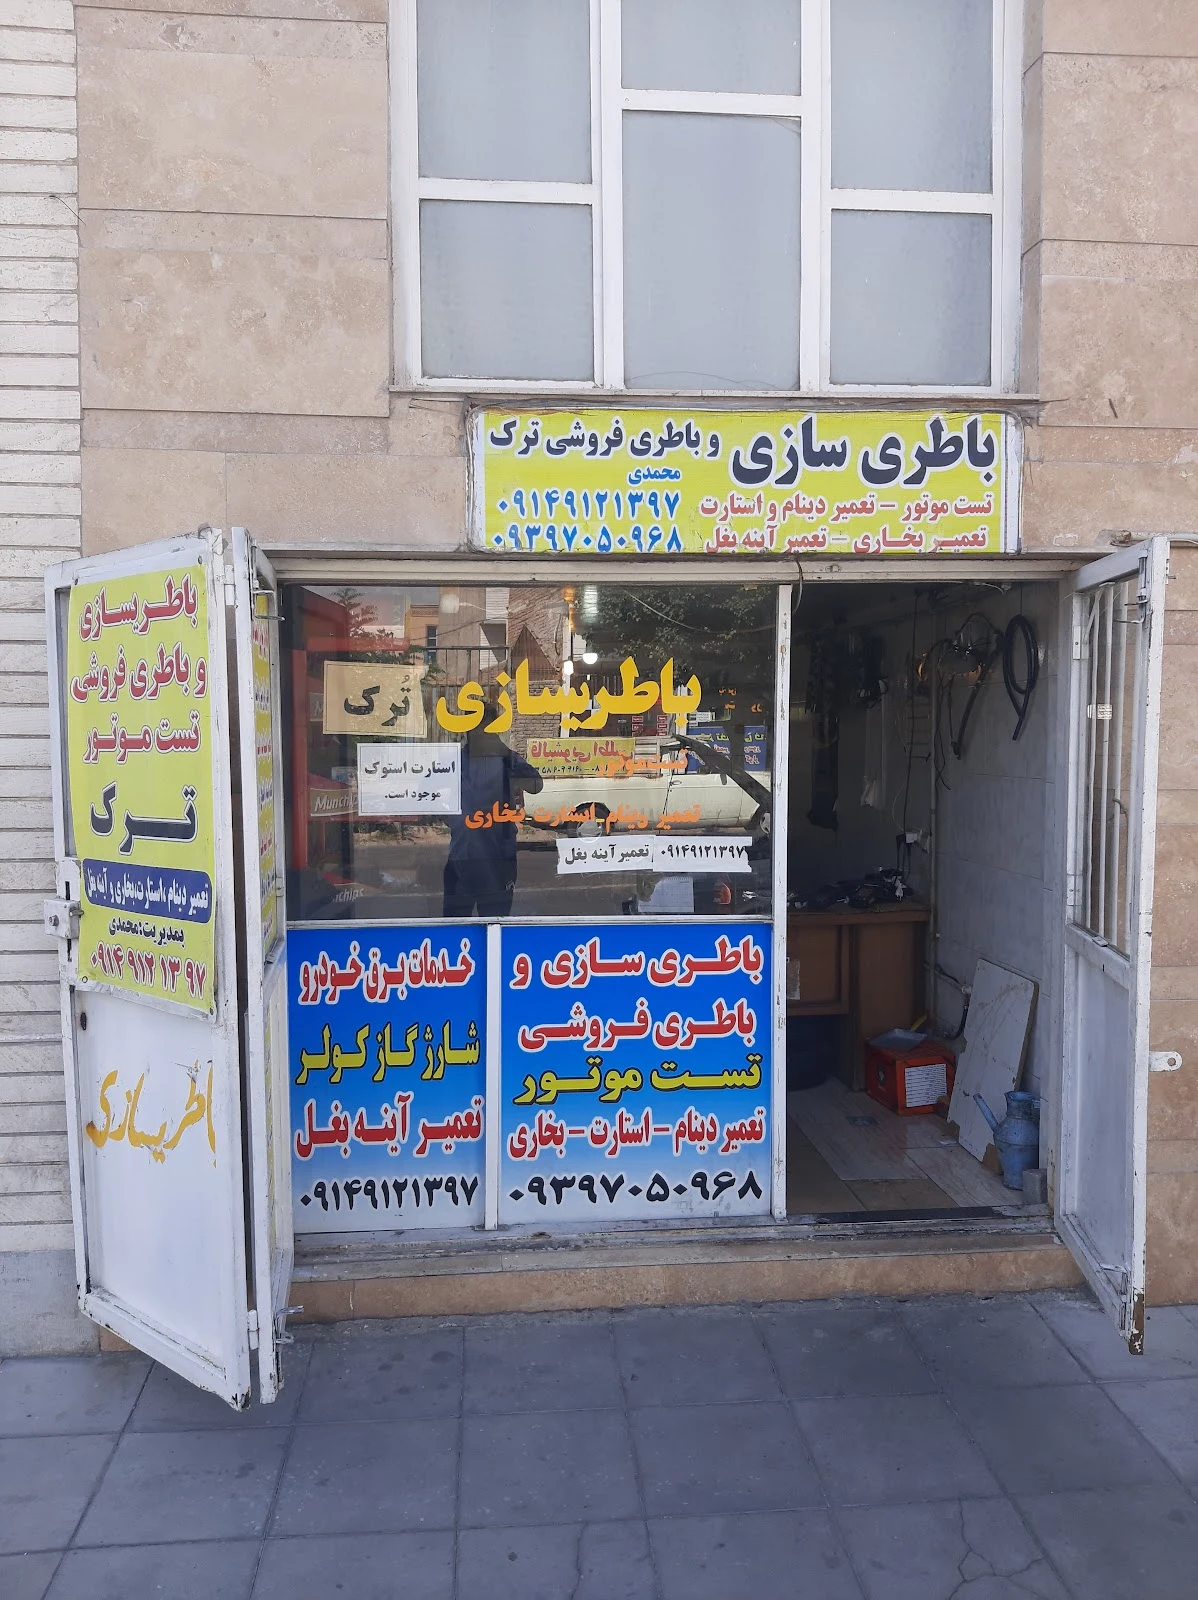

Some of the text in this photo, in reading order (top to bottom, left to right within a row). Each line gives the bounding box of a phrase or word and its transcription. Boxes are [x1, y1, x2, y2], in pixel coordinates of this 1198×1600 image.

[489, 415, 996, 486] باطری سازی و باطری فروشی ترک
[627, 464, 681, 486] محمدی
[498, 489, 680, 519] ۰۹۱۴۹۱۲۱۳۹۷
[700, 493, 763, 522] استارت
[767, 506, 777, 521] و
[781, 493, 827, 522] دینام
[830, 493, 876, 521] تعمیر
[900, 493, 948, 522] موتور
[953, 493, 993, 516] تست
[494, 524, 683, 553] ۰۹۳۹۷۰۵۰۹۶۸
[705, 527, 738, 553] بغل
[741, 524, 777, 553] آینه
[784, 526, 828, 554] تعمیر
[853, 525, 923, 553] بخاری
[928, 526, 988, 553] تعمیر
[79, 573, 199, 641] باطریسازی
[71, 646, 128, 703] فروشی
[129, 641, 190, 699] باطری
[193, 657, 207, 698] و
[435, 656, 703, 735] باطریسازی
[83, 712, 152, 764] موتور
[155, 710, 201, 753] تست
[364, 761, 456, 778] استارت استوک
[411, 791, 442, 802] موجود
[90, 782, 198, 855] ترک
[464, 801, 526, 829] بخاری
[533, 802, 596, 827] استارت
[656, 804, 700, 830] تعمیر
[564, 844, 650, 865] تعمیر آینه بغل
[660, 844, 747, 859] ۰۹۱۴۹۱۲۱۳۹۷
[299, 941, 474, 1003] خدمات برق خودرو
[512, 937, 762, 987] باطری سازی و
[520, 1000, 754, 1049] باطری فروشی
[295, 1020, 480, 1085] شارژ گاز کولر
[513, 1053, 761, 1105] تست موتور
[86, 1058, 215, 1168] اطریسازی
[296, 1093, 482, 1158] تعمیر آینه بغل
[509, 1110, 565, 1158] بخاری
[590, 1109, 650, 1156] استارت
[674, 1109, 717, 1154] دینام
[720, 1110, 764, 1153] تعمیر
[300, 1174, 479, 1212] ۰۹۱۴۹۱۲۱۳۹۷
[509, 1170, 763, 1205] ۰۹۳۹۷۰۵۰۹۶۸
